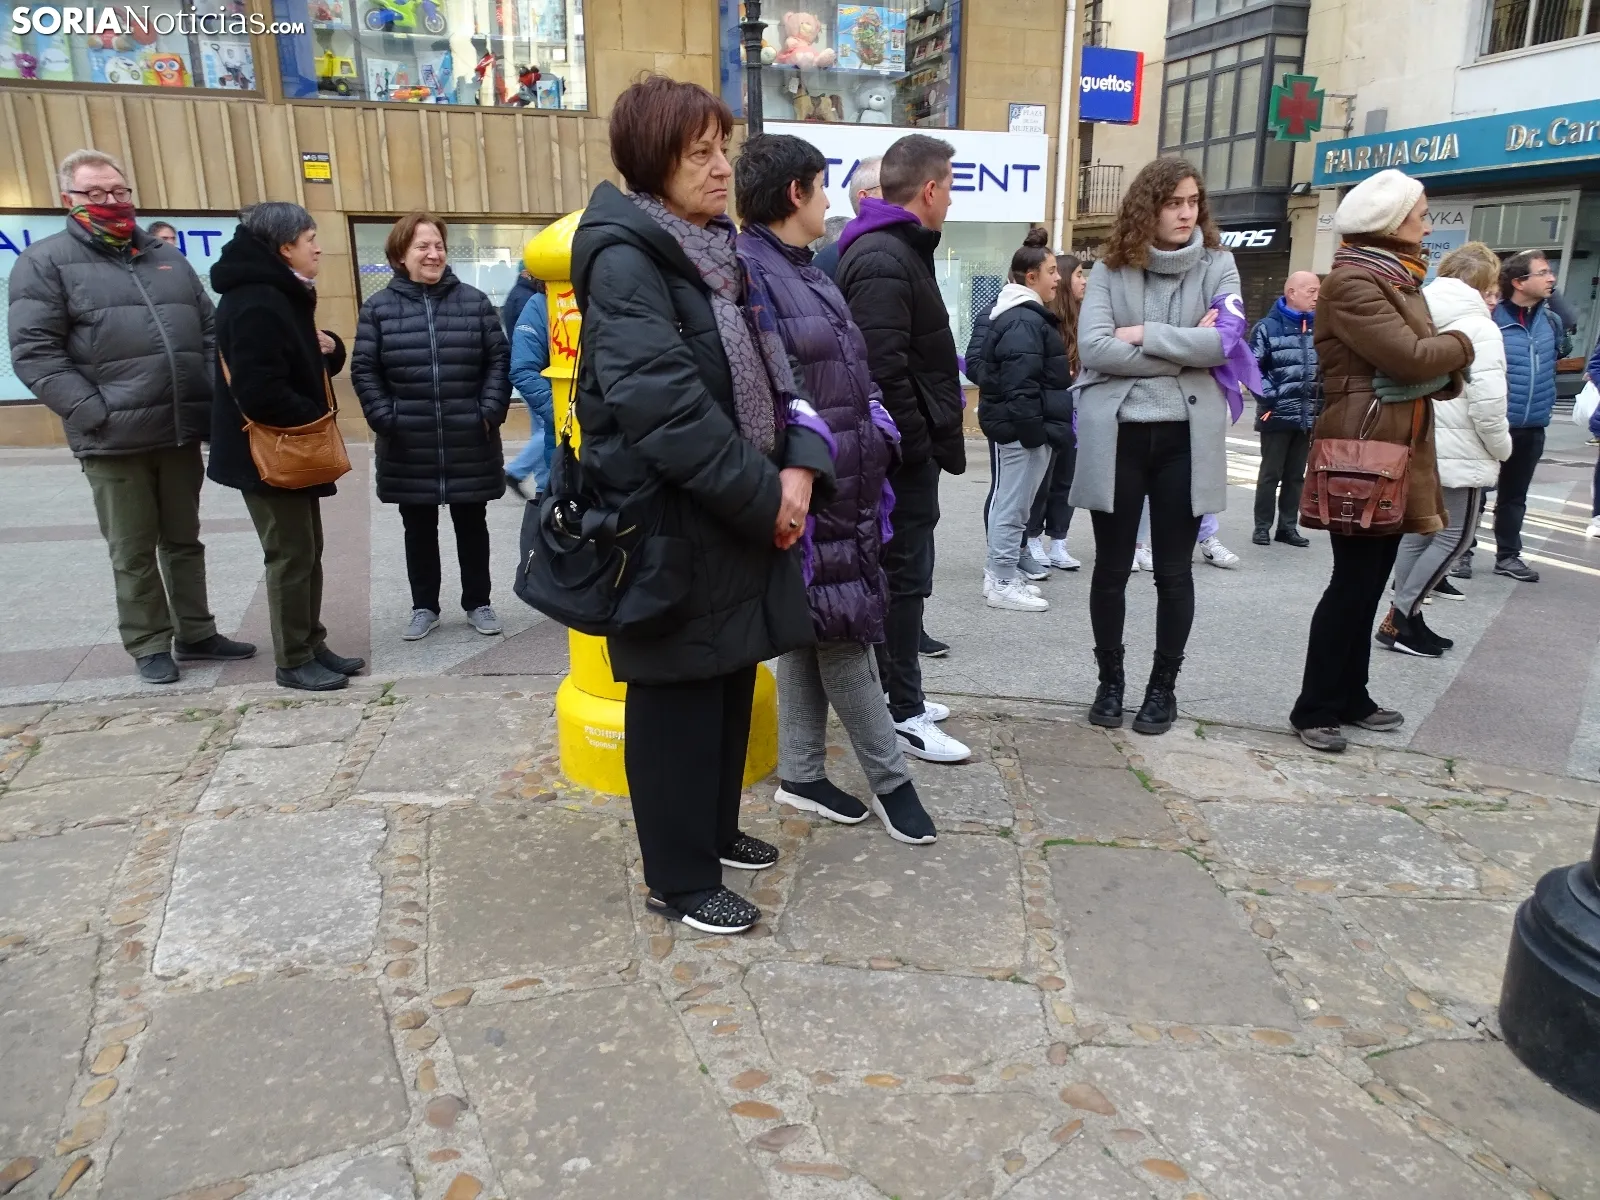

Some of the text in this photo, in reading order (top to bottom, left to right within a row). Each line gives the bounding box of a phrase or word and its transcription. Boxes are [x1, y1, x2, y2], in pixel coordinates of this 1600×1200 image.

[1022, 109, 1043, 117] PLAZA
[1011, 125, 1042, 133] MUJERES
[1324, 117, 1600, 173] FARMACIA Dr. Car
